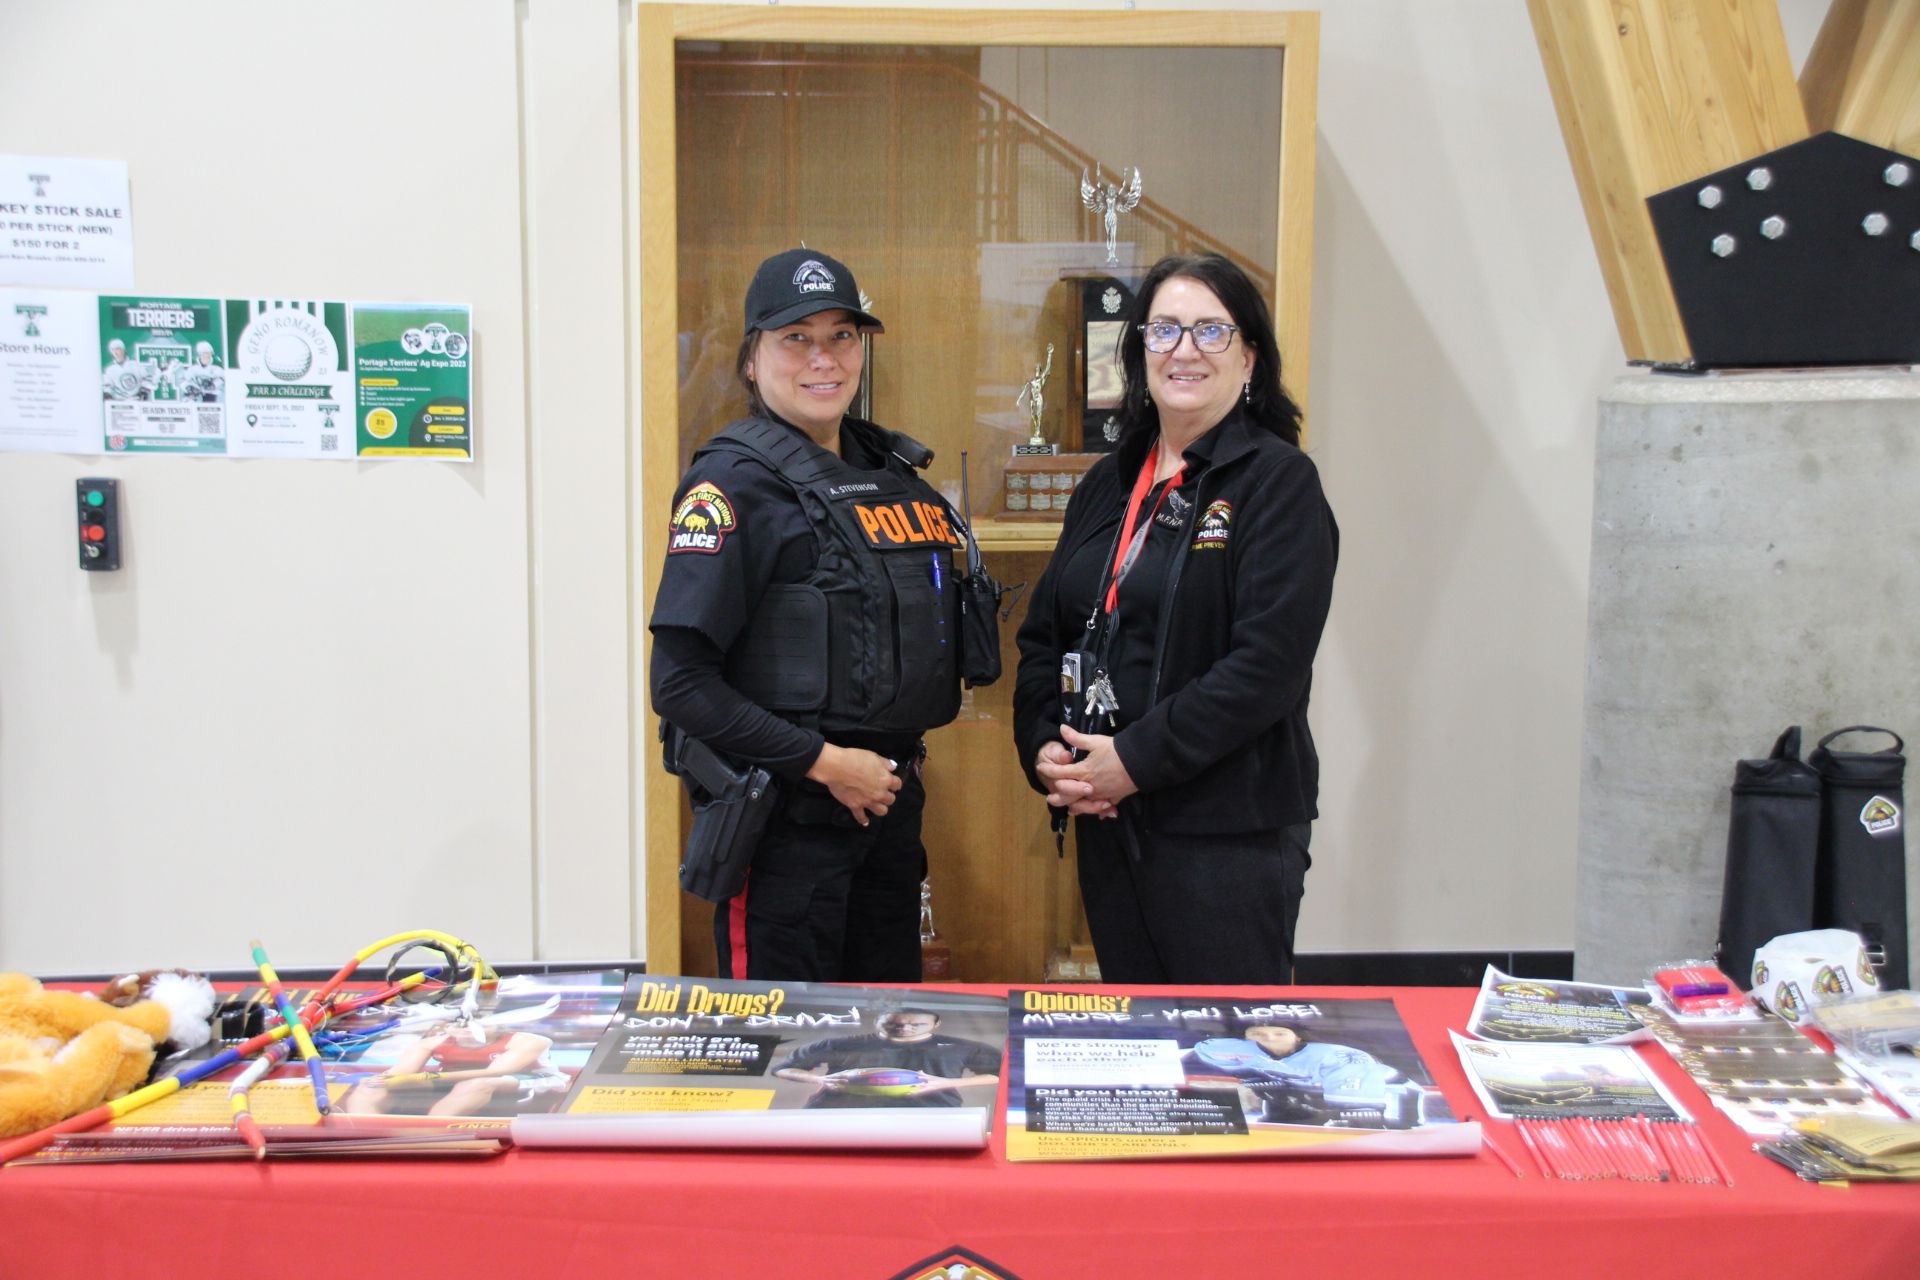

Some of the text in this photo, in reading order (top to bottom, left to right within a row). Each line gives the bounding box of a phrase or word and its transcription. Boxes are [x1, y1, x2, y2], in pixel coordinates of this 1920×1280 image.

[34, 204, 80, 217] STICK
[85, 207, 122, 219] SALE
[9, 222, 34, 231] PER
[37, 223, 74, 233] STICK
[77, 225, 113, 236] (NEW)
[45, 240, 70, 250] FOR
[803, 282, 832, 291] POLICE
[127, 308, 195, 329] TERRIERS
[247, 317, 330, 356] GENO ROMANOW
[34, 344, 71, 355] Hours
[359, 357, 388, 368] Portage
[420, 359, 431, 369] Ag
[432, 359, 449, 369] Expo
[252, 386, 270, 396] PAR
[277, 386, 325, 399] CHALLENGE
[830, 483, 879, 496] A. STEVENSON
[673, 492, 733, 527] MANITOBA FIRST NATIONS
[855, 501, 959, 545] POLICE
[1198, 529, 1229, 539] POLICE
[673, 532, 718, 550] POLICE
[1203, 541, 1226, 550] PREVEN
[636, 982, 786, 1017] Did Drugs?
[1023, 990, 1131, 1013] Opioids?
[1503, 991, 1546, 1000] POLICE
[623, 1011, 738, 1030] DON'T
[1022, 1011, 1134, 1026] MISUSE
[627, 1034, 742, 1044] you only get
[662, 1042, 705, 1050] shot
[729, 1042, 760, 1050] life
[1086, 1042, 1159, 1050] stronger
[688, 1048, 704, 1057] it
[705, 1050, 761, 1058] count
[1036, 1049, 1083, 1057] when
[1117, 1049, 1157, 1058] help
[113, 1125, 161, 1133] NEVER
[161, 1125, 199, 1133] drive
